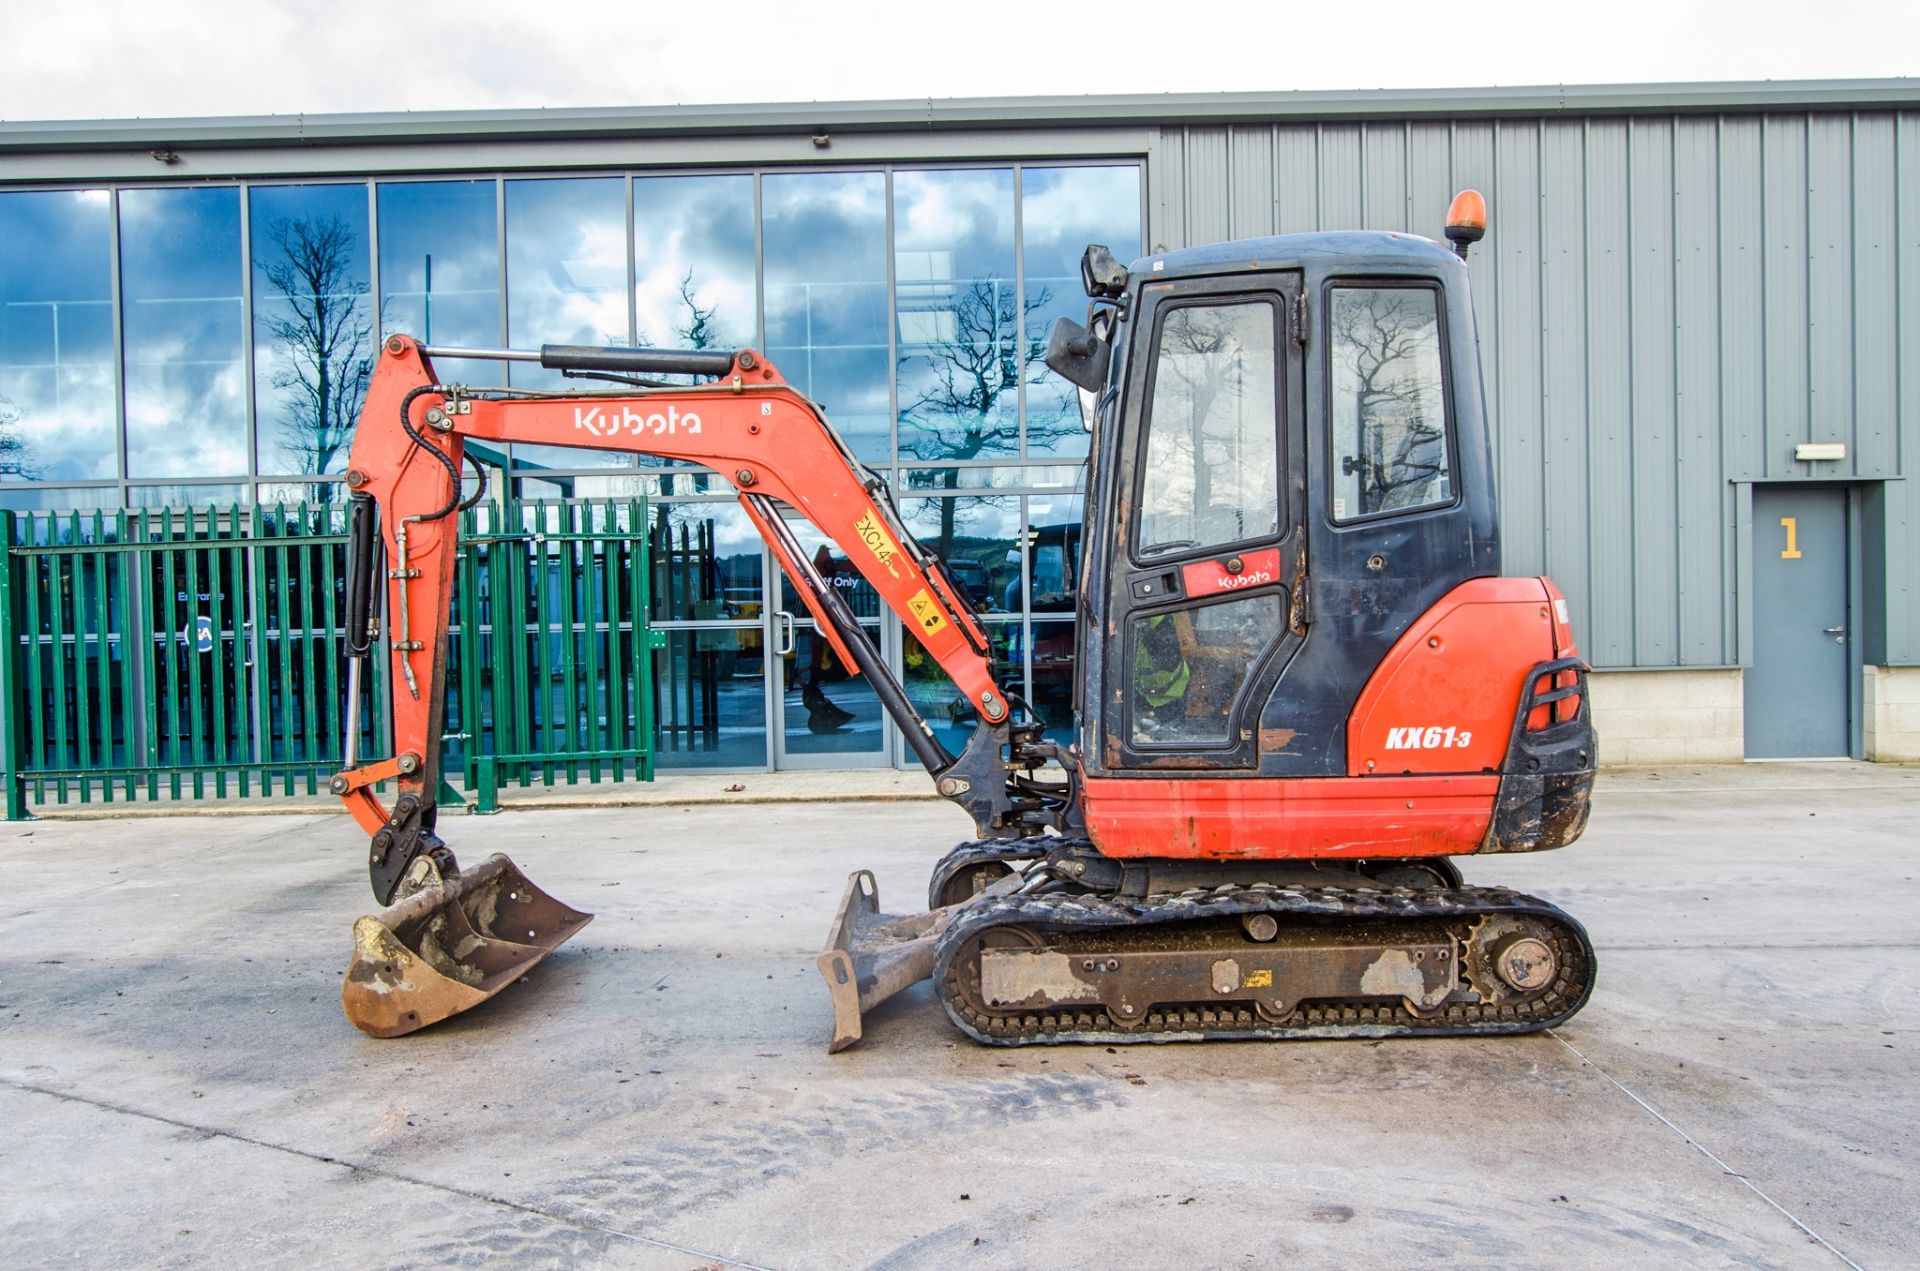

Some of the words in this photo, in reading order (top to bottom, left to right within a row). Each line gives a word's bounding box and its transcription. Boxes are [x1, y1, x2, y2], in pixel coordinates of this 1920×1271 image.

[575, 406, 702, 436] Kubota
[1781, 517, 1802, 559] 1
[834, 576, 859, 589] Only
[1218, 570, 1271, 588] Kubota
[1384, 726, 1473, 750] KX61-3
